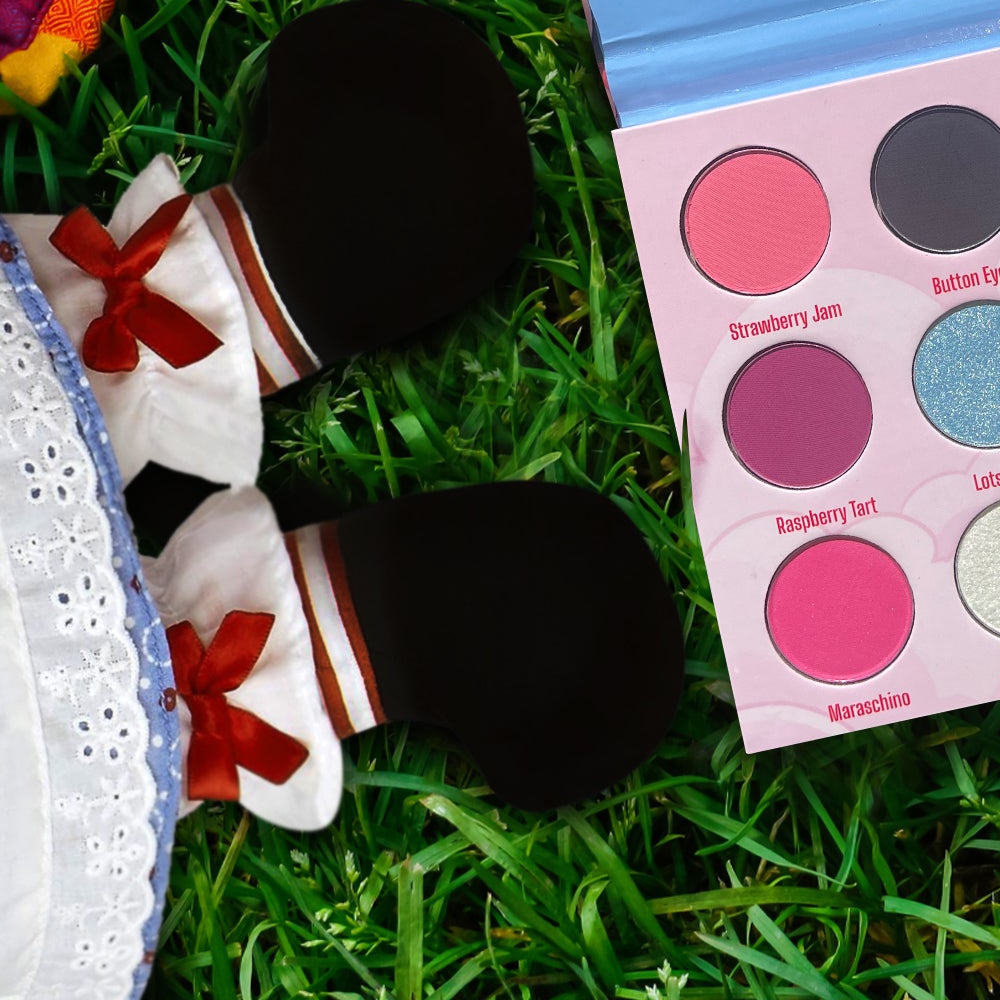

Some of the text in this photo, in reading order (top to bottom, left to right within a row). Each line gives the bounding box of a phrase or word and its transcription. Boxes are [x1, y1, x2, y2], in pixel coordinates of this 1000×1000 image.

[931, 272, 981, 295] Button
[728, 302, 843, 342] Strawberry Jam
[775, 496, 879, 535] Raspberry Tart
[827, 691, 912, 723] Maraschino
